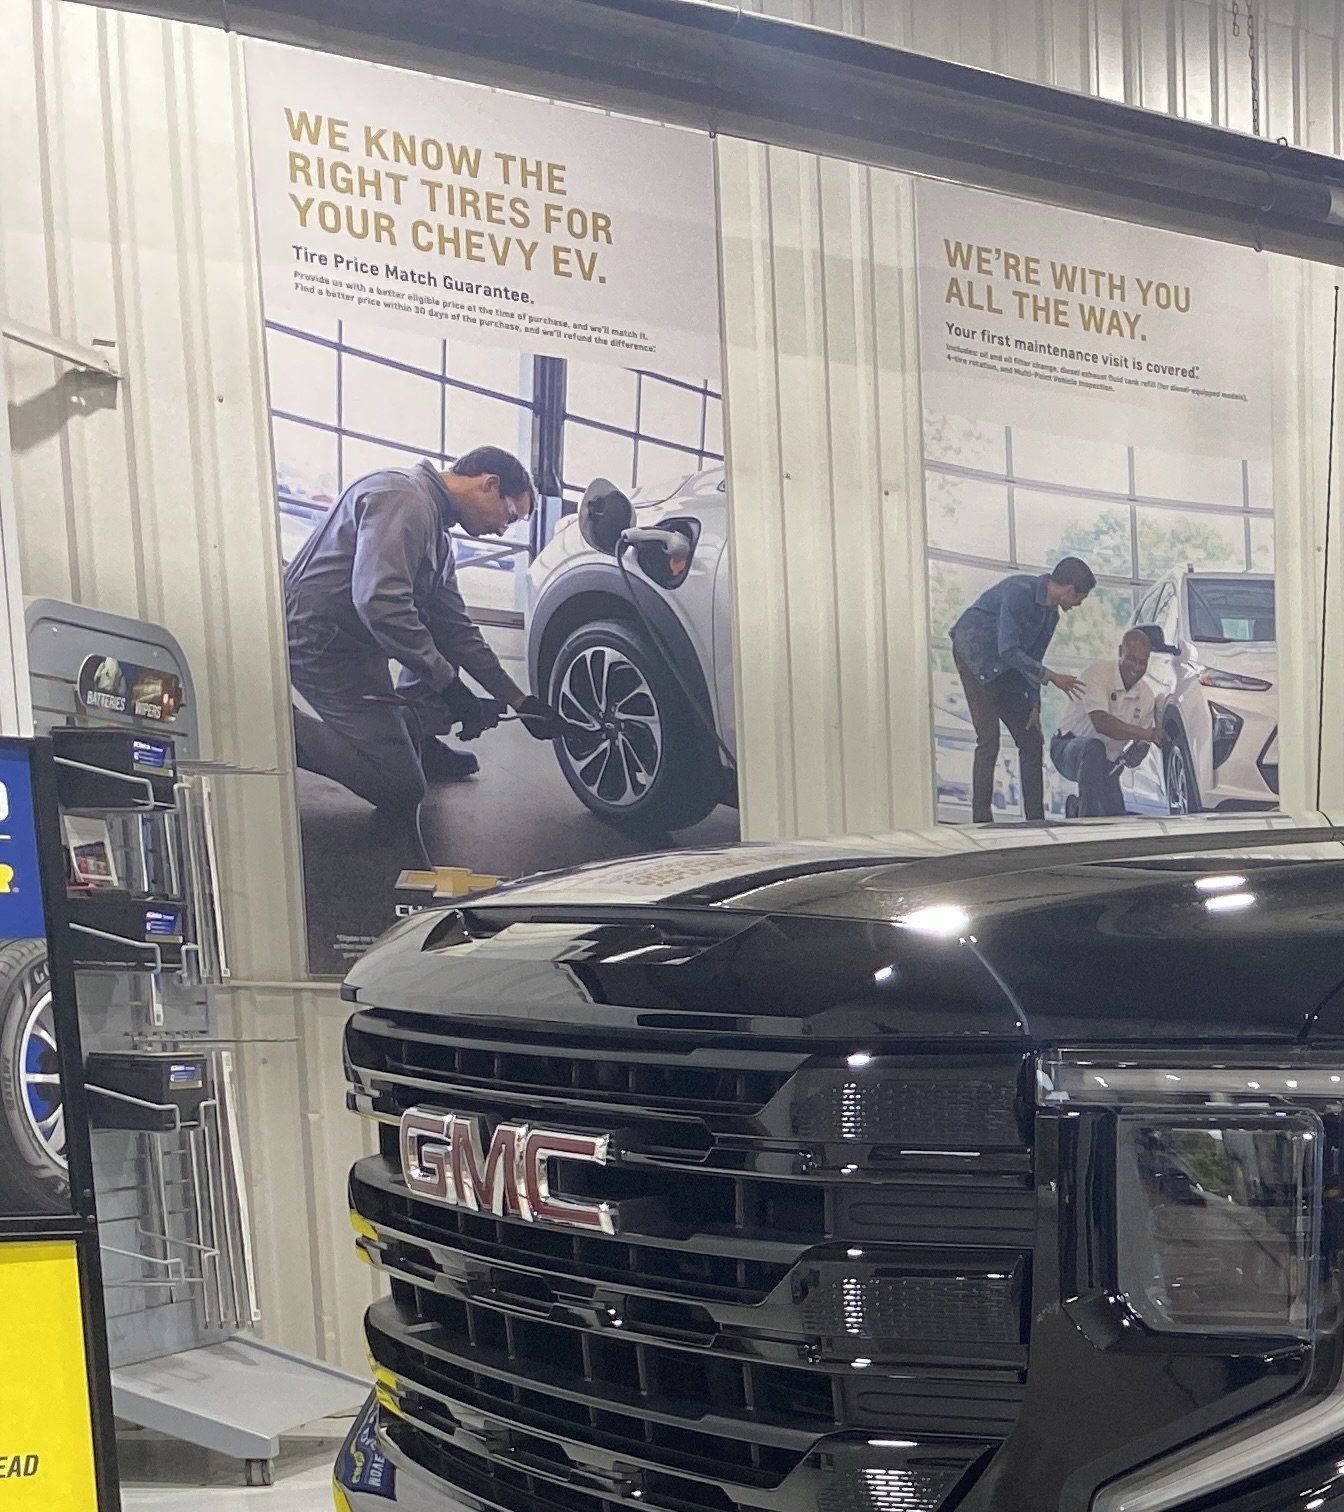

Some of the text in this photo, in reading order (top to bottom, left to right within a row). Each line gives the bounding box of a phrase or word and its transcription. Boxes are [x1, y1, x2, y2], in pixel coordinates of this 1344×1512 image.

[284, 107, 567, 195] WE KNOW THE
[288, 151, 613, 244] RIGHT TIRES FOR
[289, 193, 607, 284] YOUR CHEVY EV.
[292, 245, 535, 305] Tire Price Match Guarantee.
[294, 270, 329, 285] Provide
[333, 279, 343, 287] us
[345, 281, 366, 292] with
[376, 286, 405, 299] better
[408, 293, 440, 306] eligible
[442, 298, 465, 310] price
[479, 306, 493, 316] the
[496, 308, 515, 319] time
[573, 321, 588, 331] and
[611, 328, 638, 339] match
[944, 239, 1191, 313] WE'RE WITH YOU
[945, 277, 1148, 341] ALL THE WAY.
[295, 282, 315, 294] Find
[326, 289, 355, 301] better
[357, 296, 381, 307] price
[383, 301, 412, 313] within
[428, 308, 449, 320] days
[564, 332, 592, 343] refund
[946, 321, 976, 340] Your
[981, 328, 1011, 348] first
[1014, 337, 1098, 364] maintenance
[1101, 352, 1129, 369] visit
[1132, 357, 1142, 371] is
[86, 690, 126, 711] BATTERIES
[399, 1106, 618, 1236] GMC
